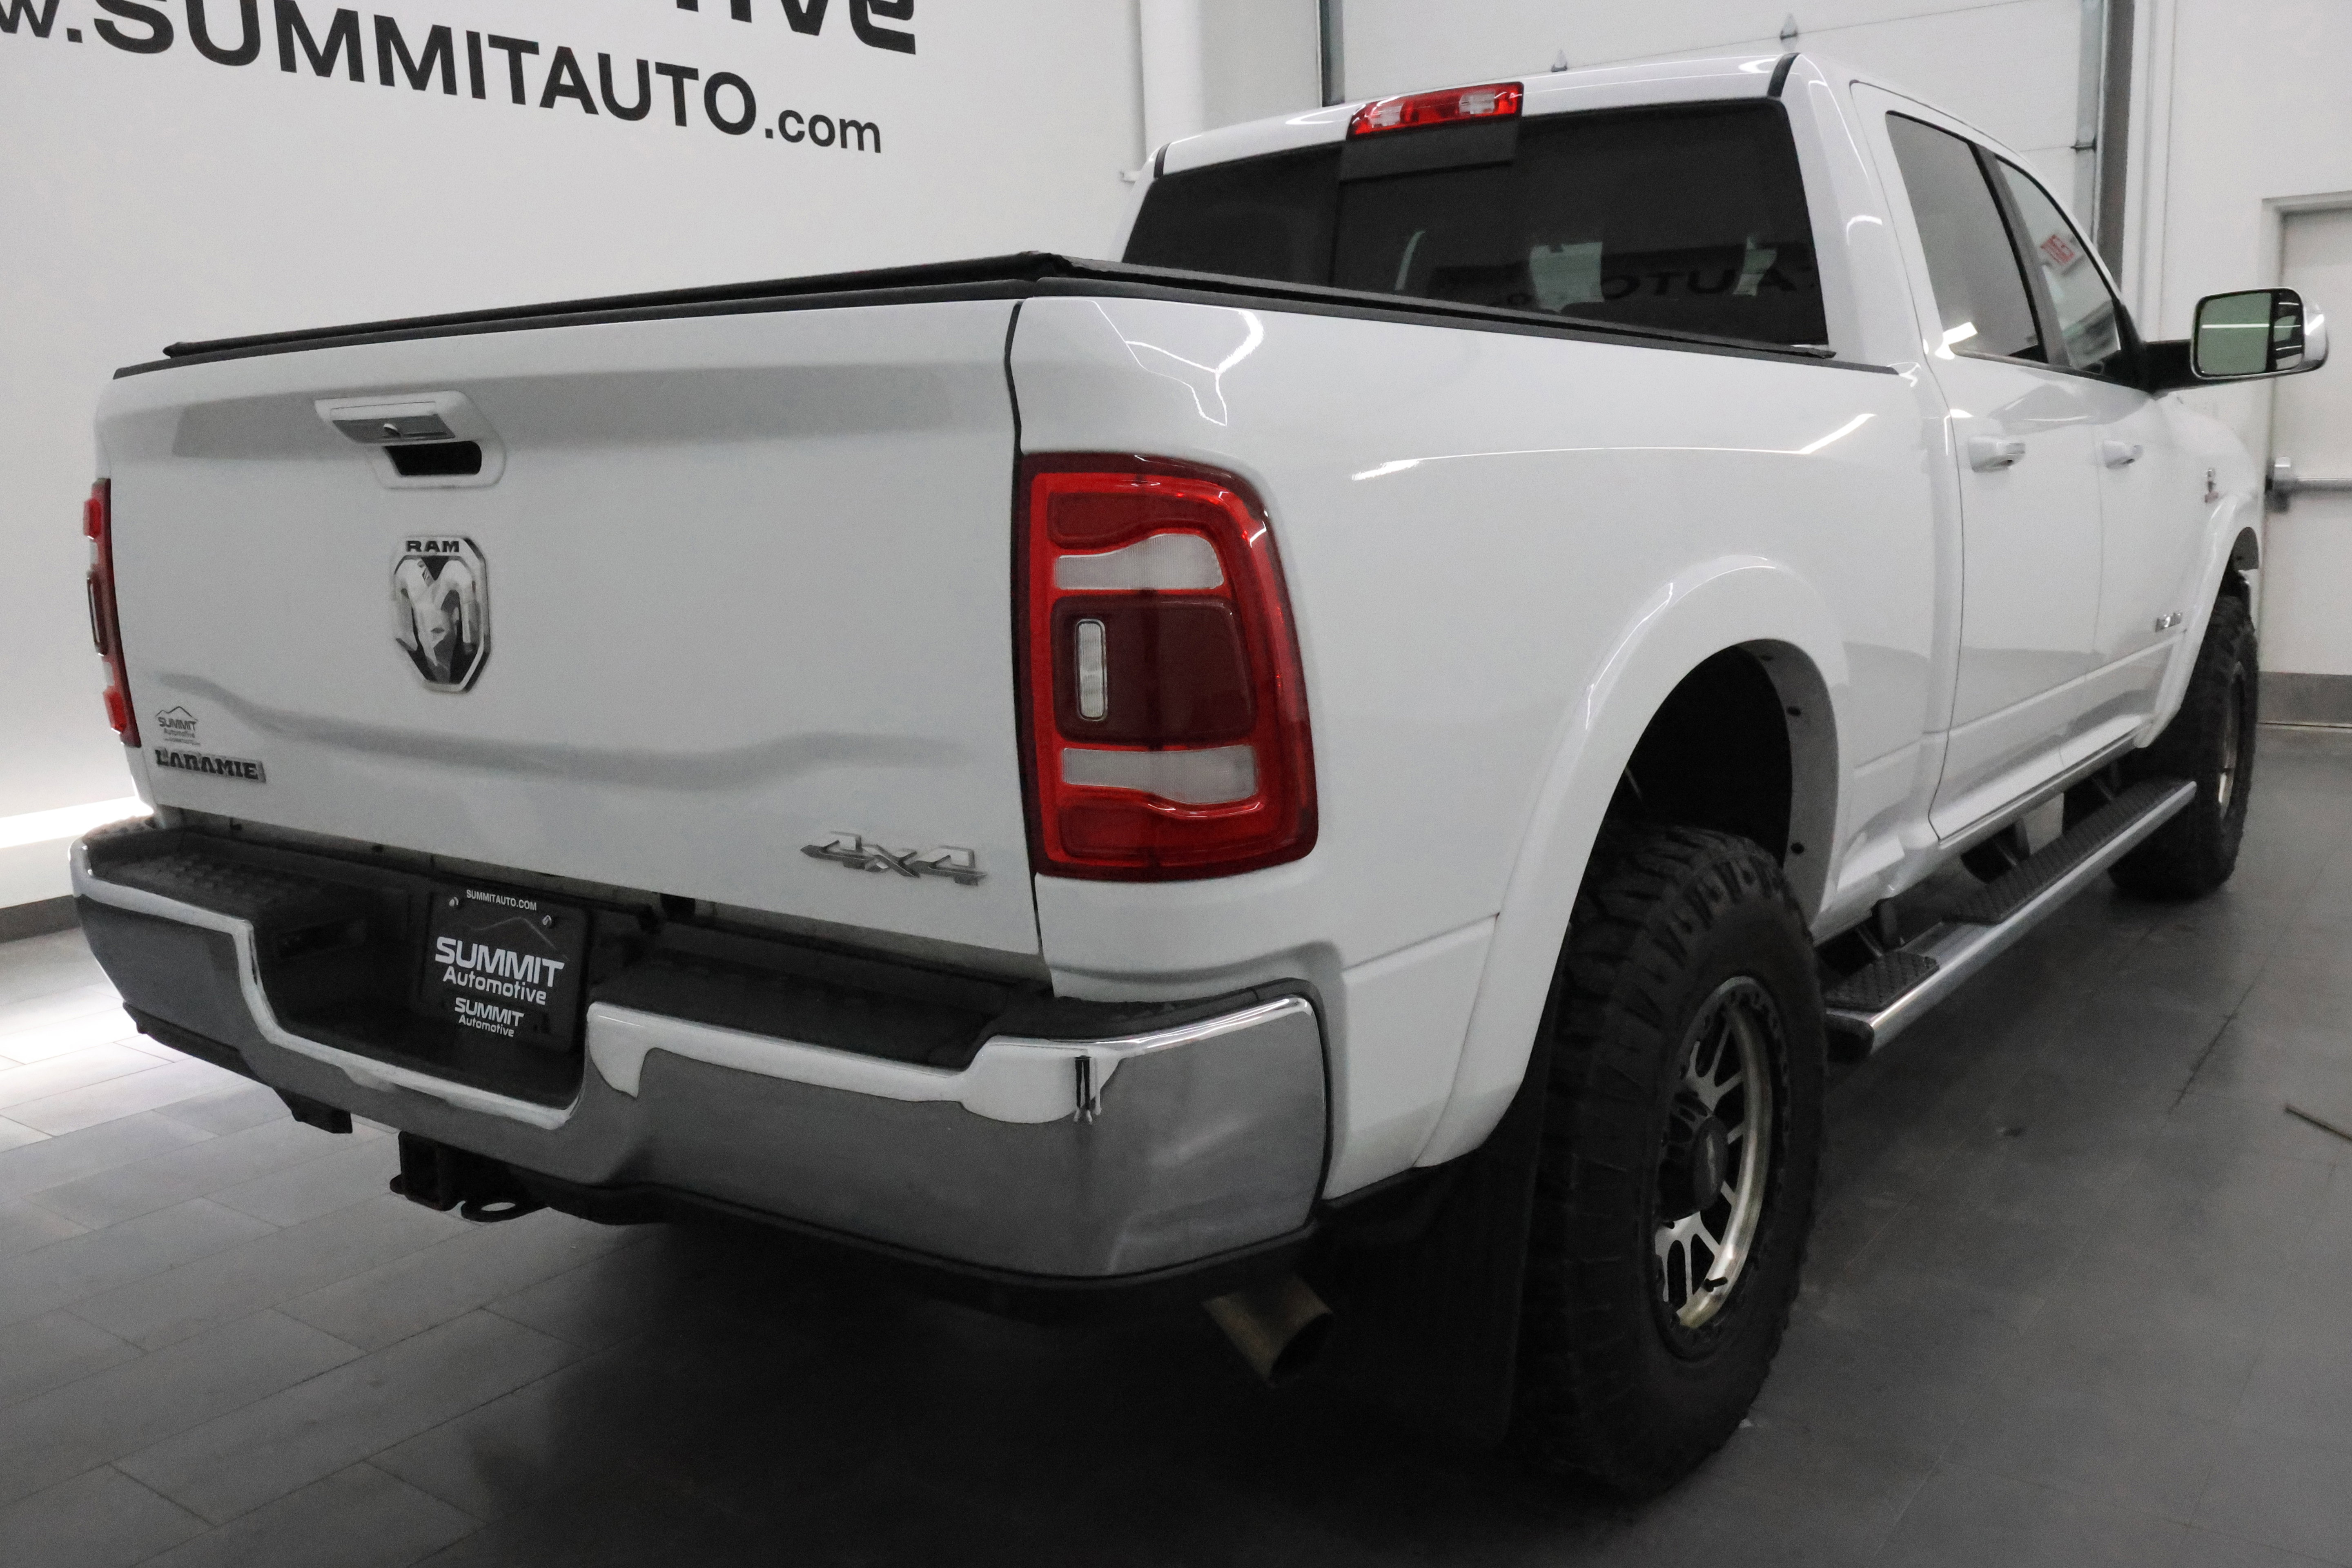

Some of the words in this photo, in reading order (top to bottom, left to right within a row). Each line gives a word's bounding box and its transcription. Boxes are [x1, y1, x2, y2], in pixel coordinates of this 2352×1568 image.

[405, 540, 460, 553] RAM
[158, 717, 197, 731] SUMMIT
[155, 748, 265, 782] LARAMIE
[466, 889, 537, 911] SUMMITAUTO.COM
[435, 936, 565, 988] SUMMIT
[443, 966, 547, 1005] Automotive
[454, 997, 525, 1027] SUMMIT
[459, 1014, 514, 1038] Automotive
